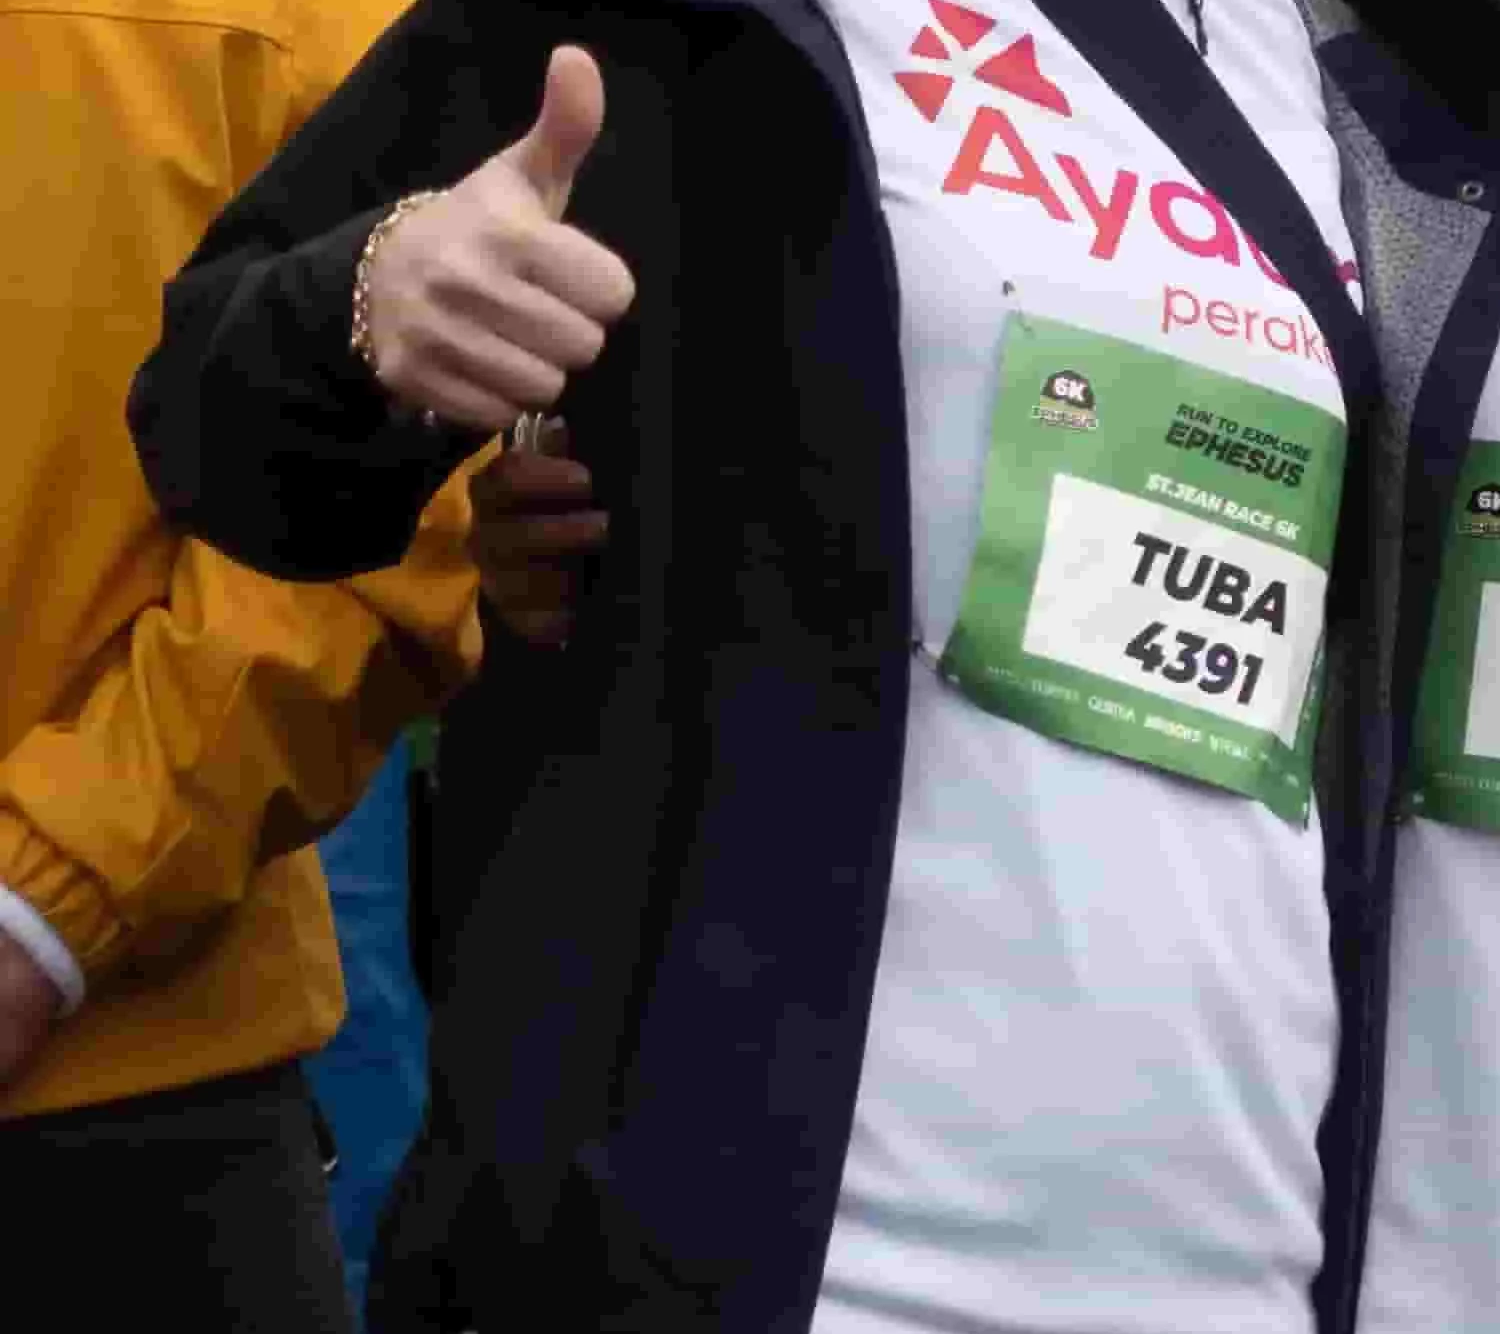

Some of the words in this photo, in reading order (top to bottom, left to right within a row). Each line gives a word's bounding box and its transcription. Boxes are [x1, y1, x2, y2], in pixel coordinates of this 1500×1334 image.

[1162, 283, 1336, 374] perak
[1053, 376, 1087, 402] 6K
[1165, 419, 1304, 488] EPHESUS
[1177, 403, 1213, 425] RUN
[1217, 417, 1239, 434] TO
[1241, 426, 1312, 462] EXPLORE
[1223, 500, 1274, 532] RACE
[1274, 520, 1301, 541] 6K
[1131, 531, 1287, 635] TUBA
[1124, 621, 1264, 705] 4391
